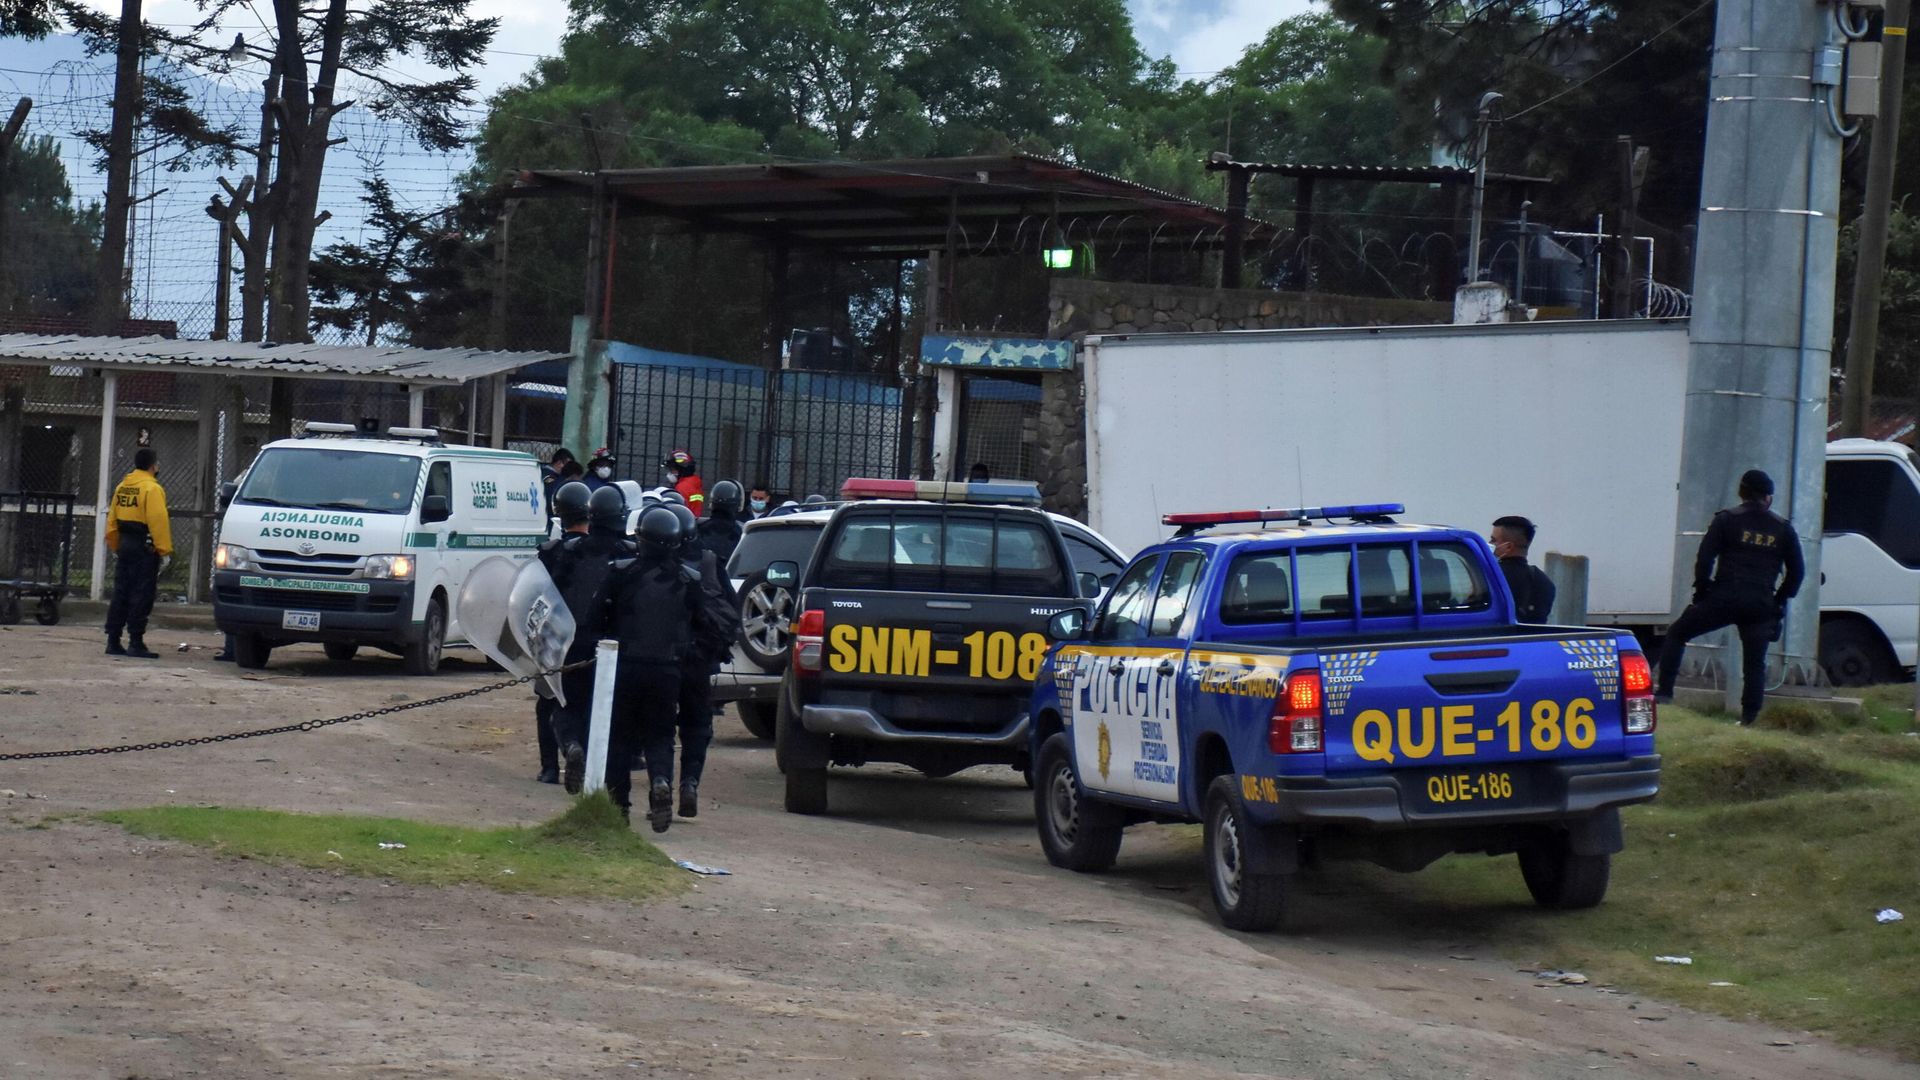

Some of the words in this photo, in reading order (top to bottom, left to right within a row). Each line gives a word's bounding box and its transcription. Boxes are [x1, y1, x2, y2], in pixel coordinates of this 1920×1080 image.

[475, 481, 497, 494] 1554
[260, 527, 360, 543] ASONBOMD
[830, 624, 1046, 681] SNM-108
[1567, 660, 1616, 669] HILUX
[1327, 675, 1365, 684] TOYOTA
[1352, 697, 1597, 764] QUE-186
[1427, 771, 1513, 803] QUE-186
